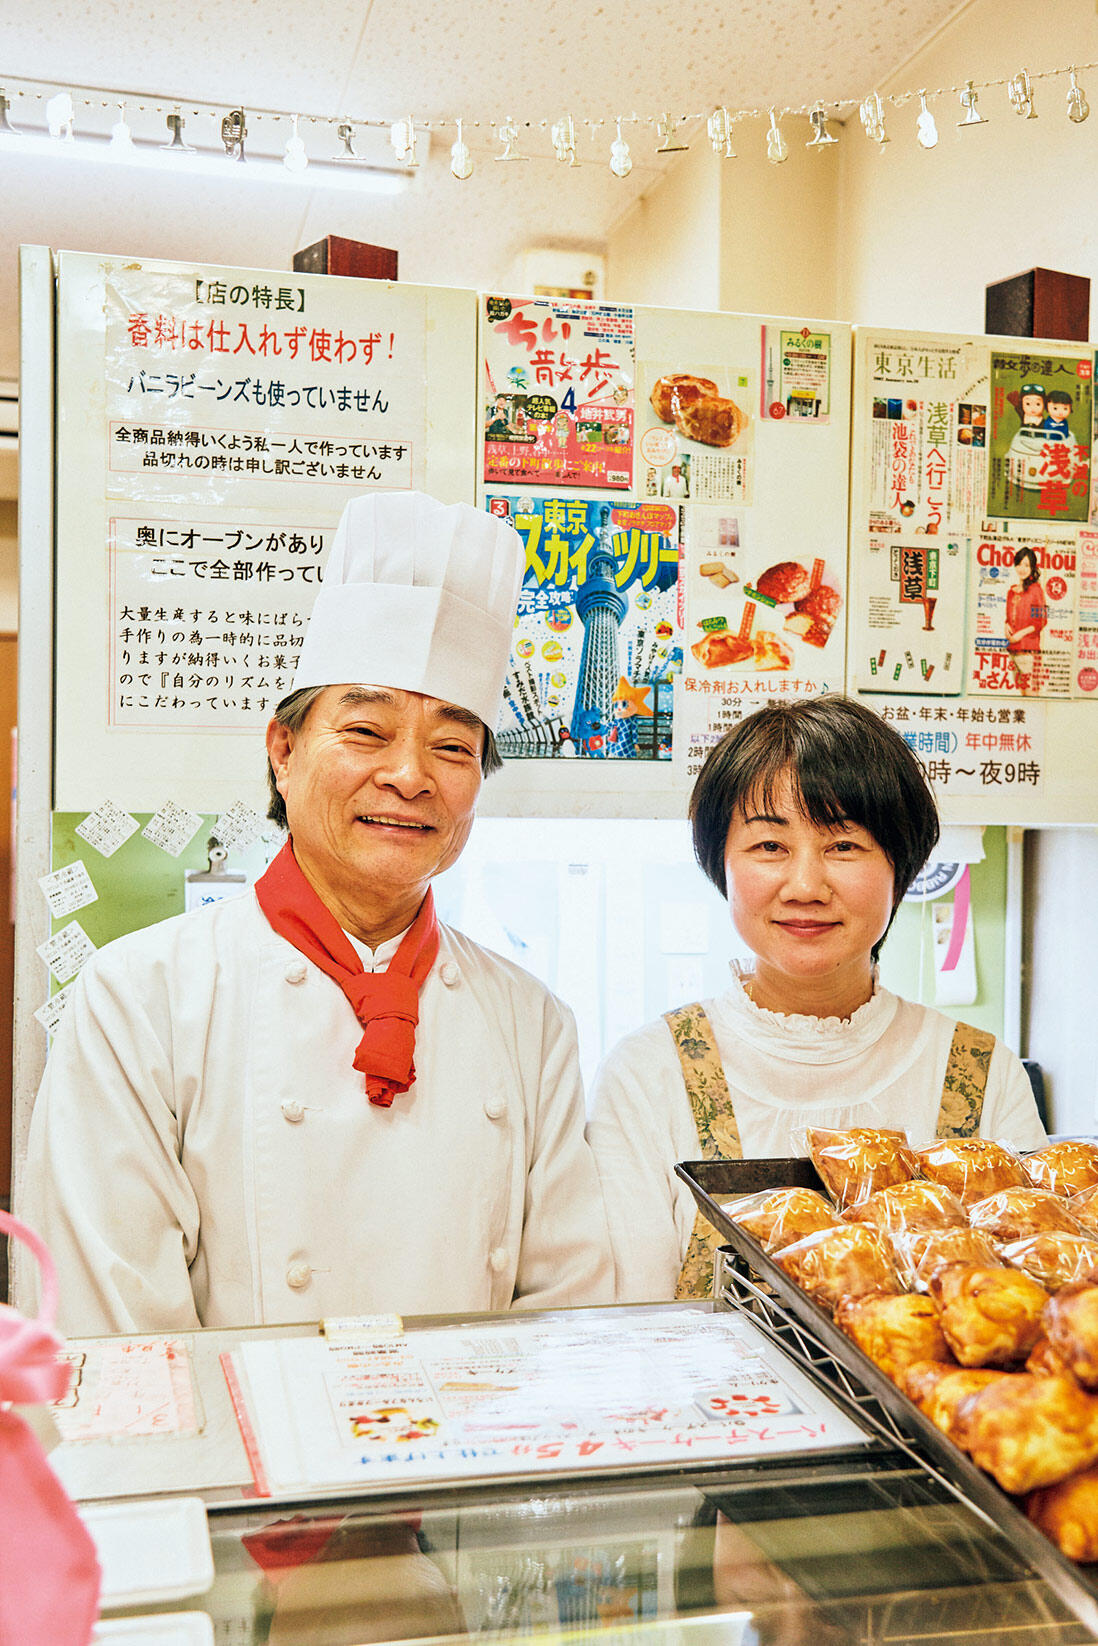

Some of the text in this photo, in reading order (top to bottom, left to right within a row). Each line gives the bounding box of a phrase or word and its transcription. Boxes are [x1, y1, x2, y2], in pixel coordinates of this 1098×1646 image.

[195, 280, 305, 312] 【店の特長】
[494, 312, 571, 352] ちい
[530, 348, 619, 397] 散歩
[874, 351, 958, 380] 東京生活
[993, 355, 1075, 378] 散歩の達人
[127, 370, 389, 413] バニラビーンズも使っていません
[561, 386, 577, 414] 4
[115, 426, 408, 461] 全商品納得いくよう私一人で作っています
[142, 451, 382, 480] 品切れの時は申し訳ございません
[890, 422, 908, 509] 池袋の達人
[926, 401, 948, 527] 浅草へ行こう
[1037, 443, 1071, 516] 浅草
[543, 499, 589, 535] 東京
[136, 526, 324, 555] 奥にオーブンがあり
[904, 552, 923, 600] 浅草
[119, 605, 311, 627] 大量生産すると味にばら
[518, 590, 572, 613] 完全攻略
[119, 628, 304, 648] 手作りの為一時的に品切
[119, 672, 294, 691] ので『自分のリズムを
[987, 671, 1031, 690] さんぽ
[717, 711, 743, 720] 1時間
[721, 698, 742, 707] 30分
[882, 706, 1026, 723] お盆・年末・年始も営業
[898, 731, 1032, 753] 業時間） 年中無休
[922, 759, 1040, 786] 時～夜9時
